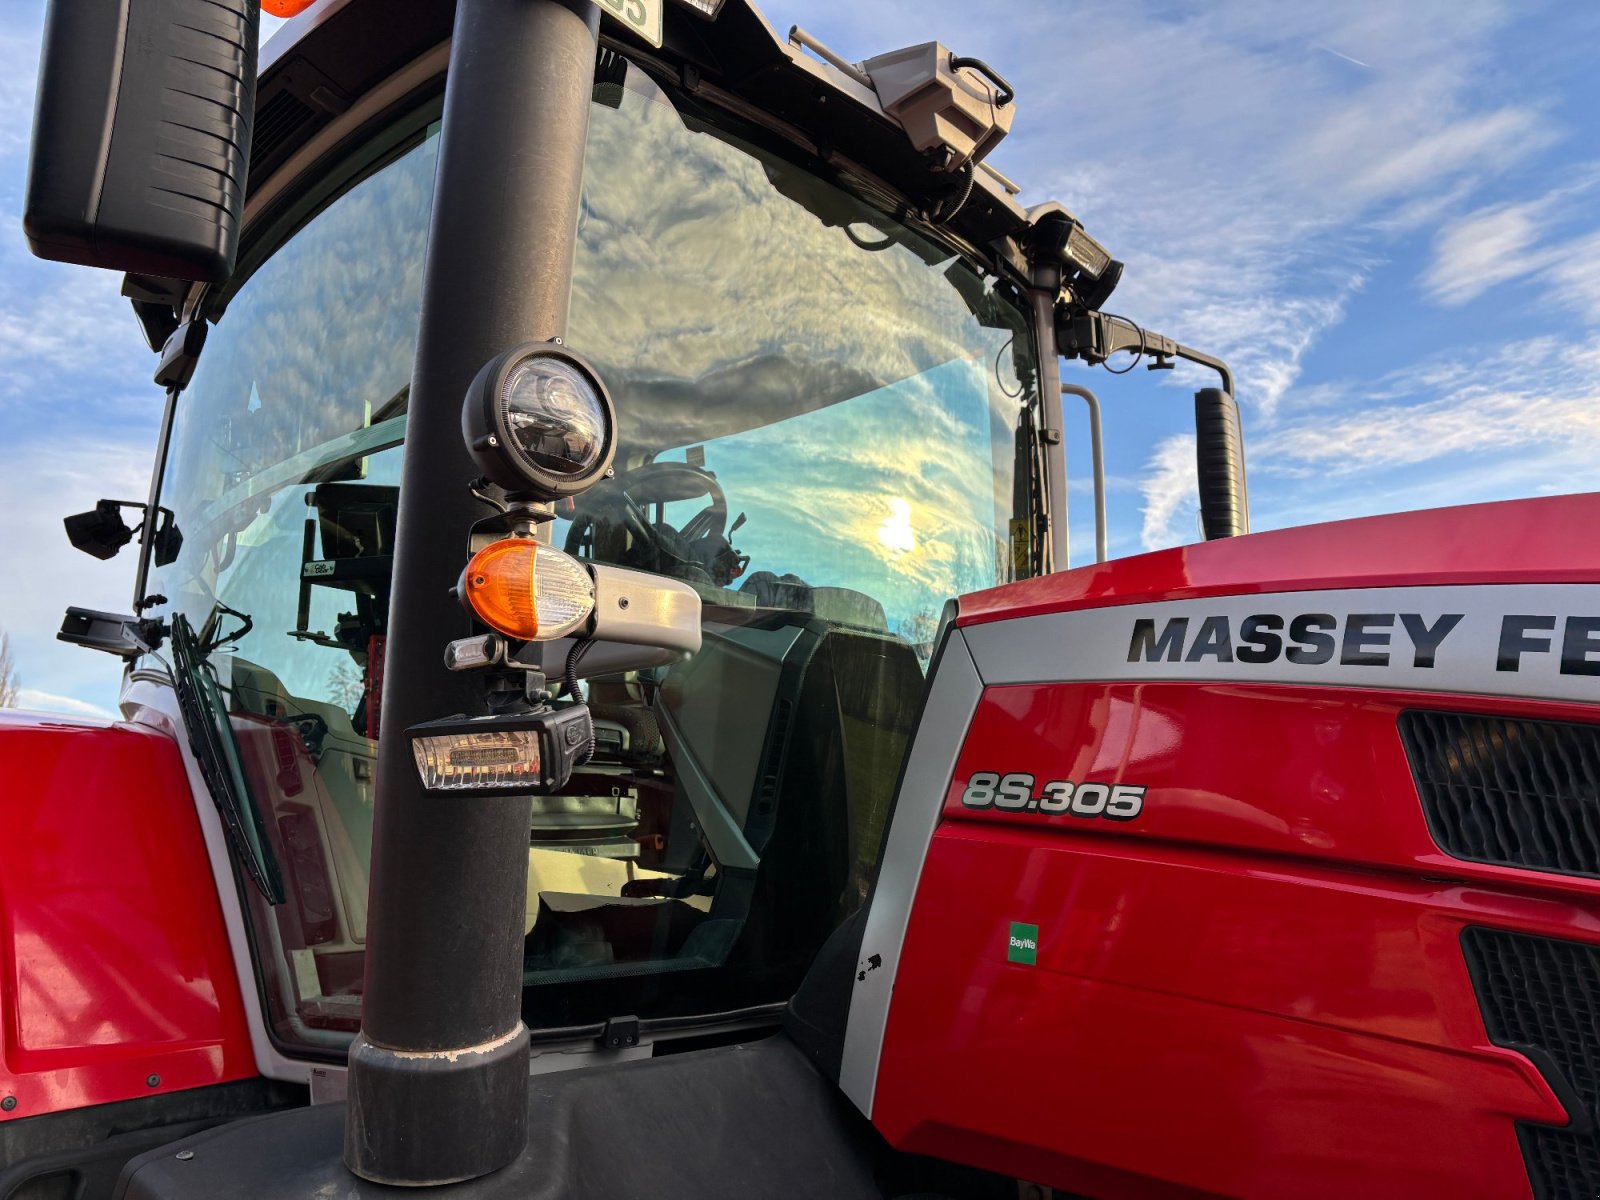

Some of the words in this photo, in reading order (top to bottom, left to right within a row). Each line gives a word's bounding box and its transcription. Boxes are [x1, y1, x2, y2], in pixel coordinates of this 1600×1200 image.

[1127, 613, 1465, 668] MASSEY
[962, 771, 1148, 821] 8S.305
[1010, 936, 1036, 950] BayWa
